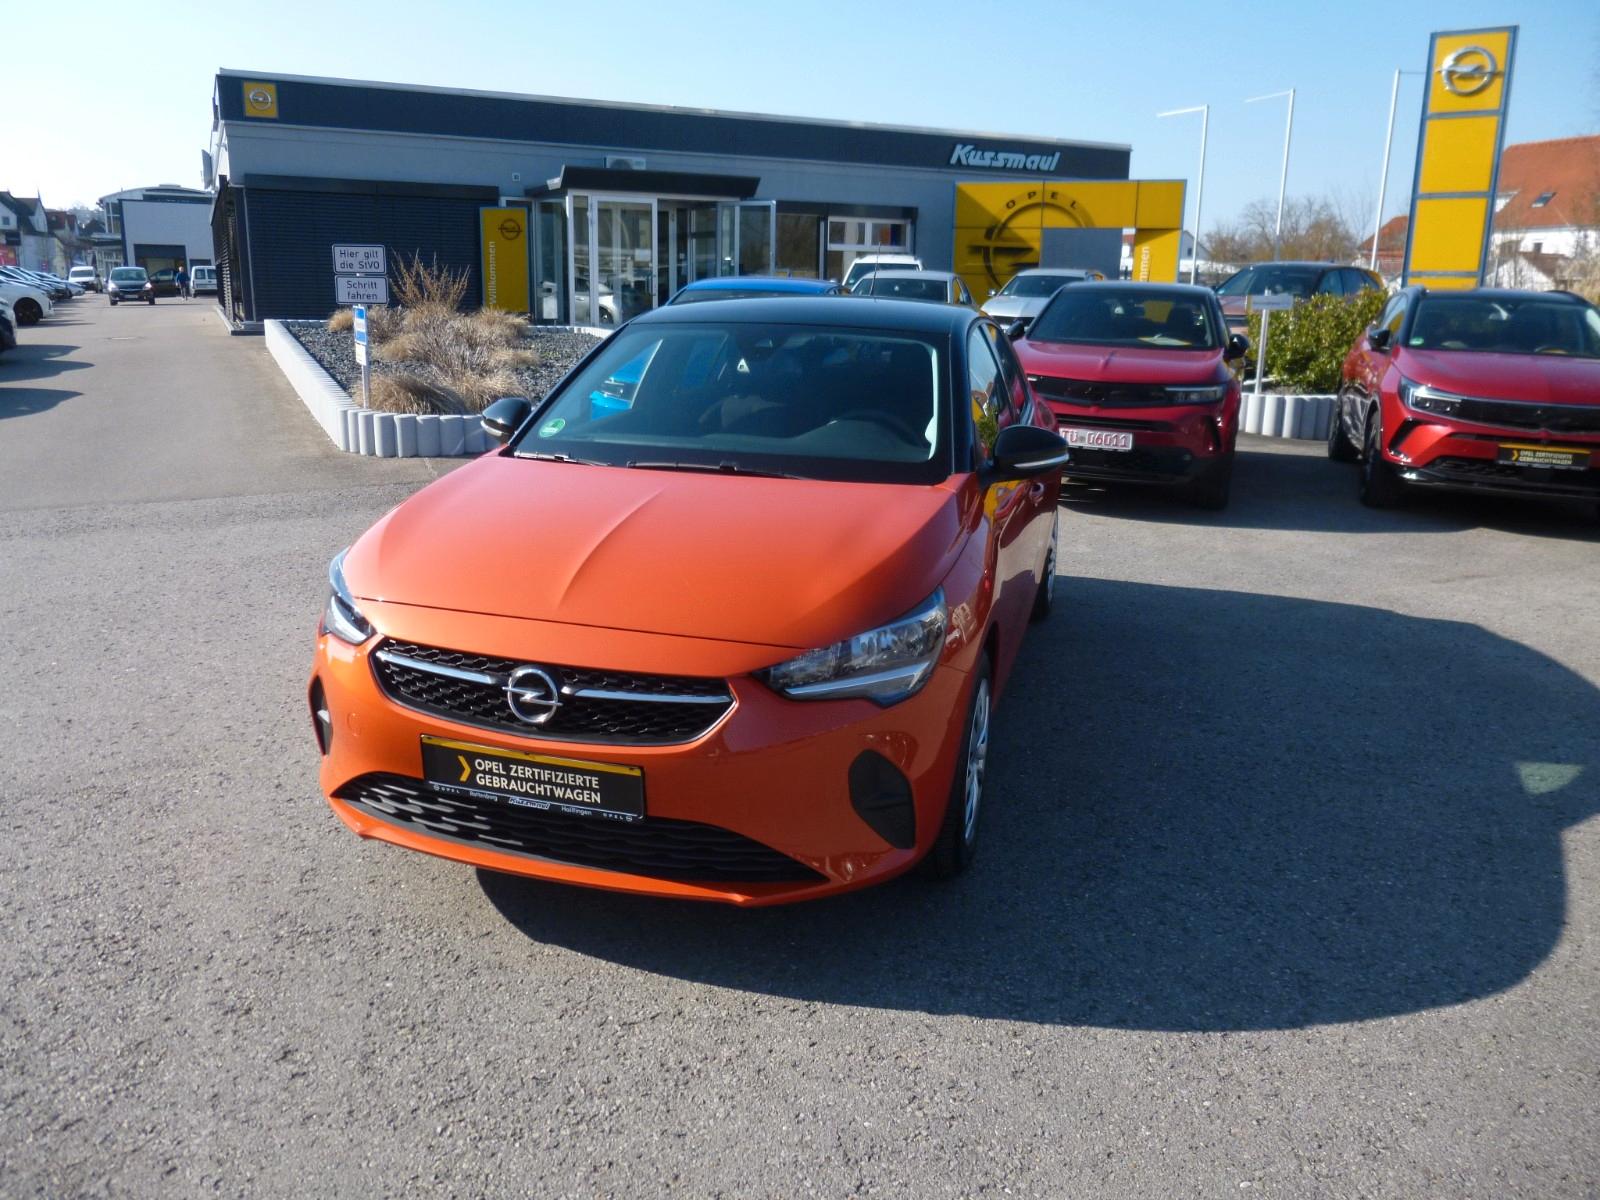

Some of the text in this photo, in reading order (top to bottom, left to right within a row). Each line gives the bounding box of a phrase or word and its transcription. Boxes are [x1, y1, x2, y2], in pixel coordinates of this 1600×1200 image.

[949, 143, 1061, 171] Kussmaul
[1006, 191, 1079, 209] OPEL
[339, 249, 379, 259] Hier gilt
[340, 260, 380, 269] die StVO
[488, 241, 497, 304] willkommen
[346, 280, 377, 289] Schritt
[347, 291, 378, 300] fahren
[474, 758, 600, 789] OPEL ZERTIFIZIERTE
[476, 773, 601, 804] GEBRAUCHTWAGEN
